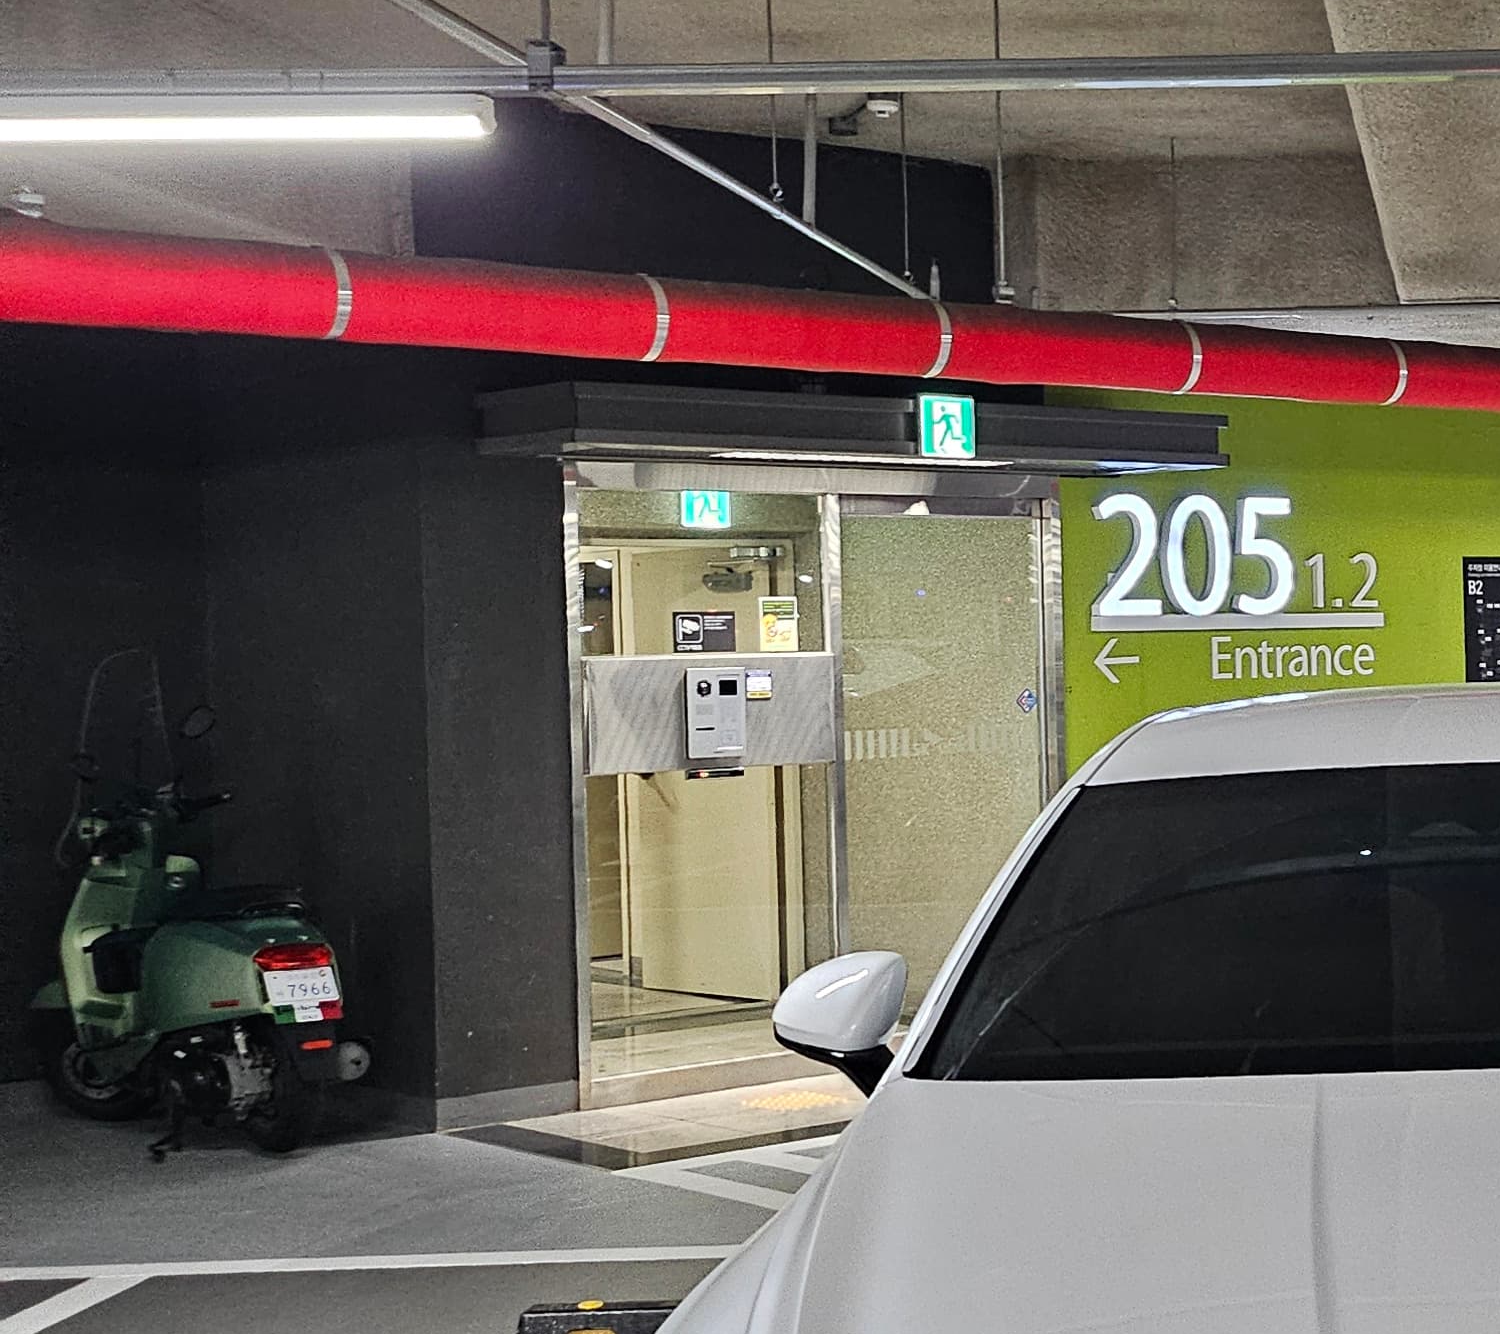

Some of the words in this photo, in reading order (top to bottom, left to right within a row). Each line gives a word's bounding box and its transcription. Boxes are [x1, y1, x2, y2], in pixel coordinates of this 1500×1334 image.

[1092, 493, 1296, 616] 205
[1304, 553, 1379, 608] 1.2
[1468, 580, 1484, 596] B2
[1211, 636, 1376, 680] Entrance
[287, 982, 331, 998] 7966
